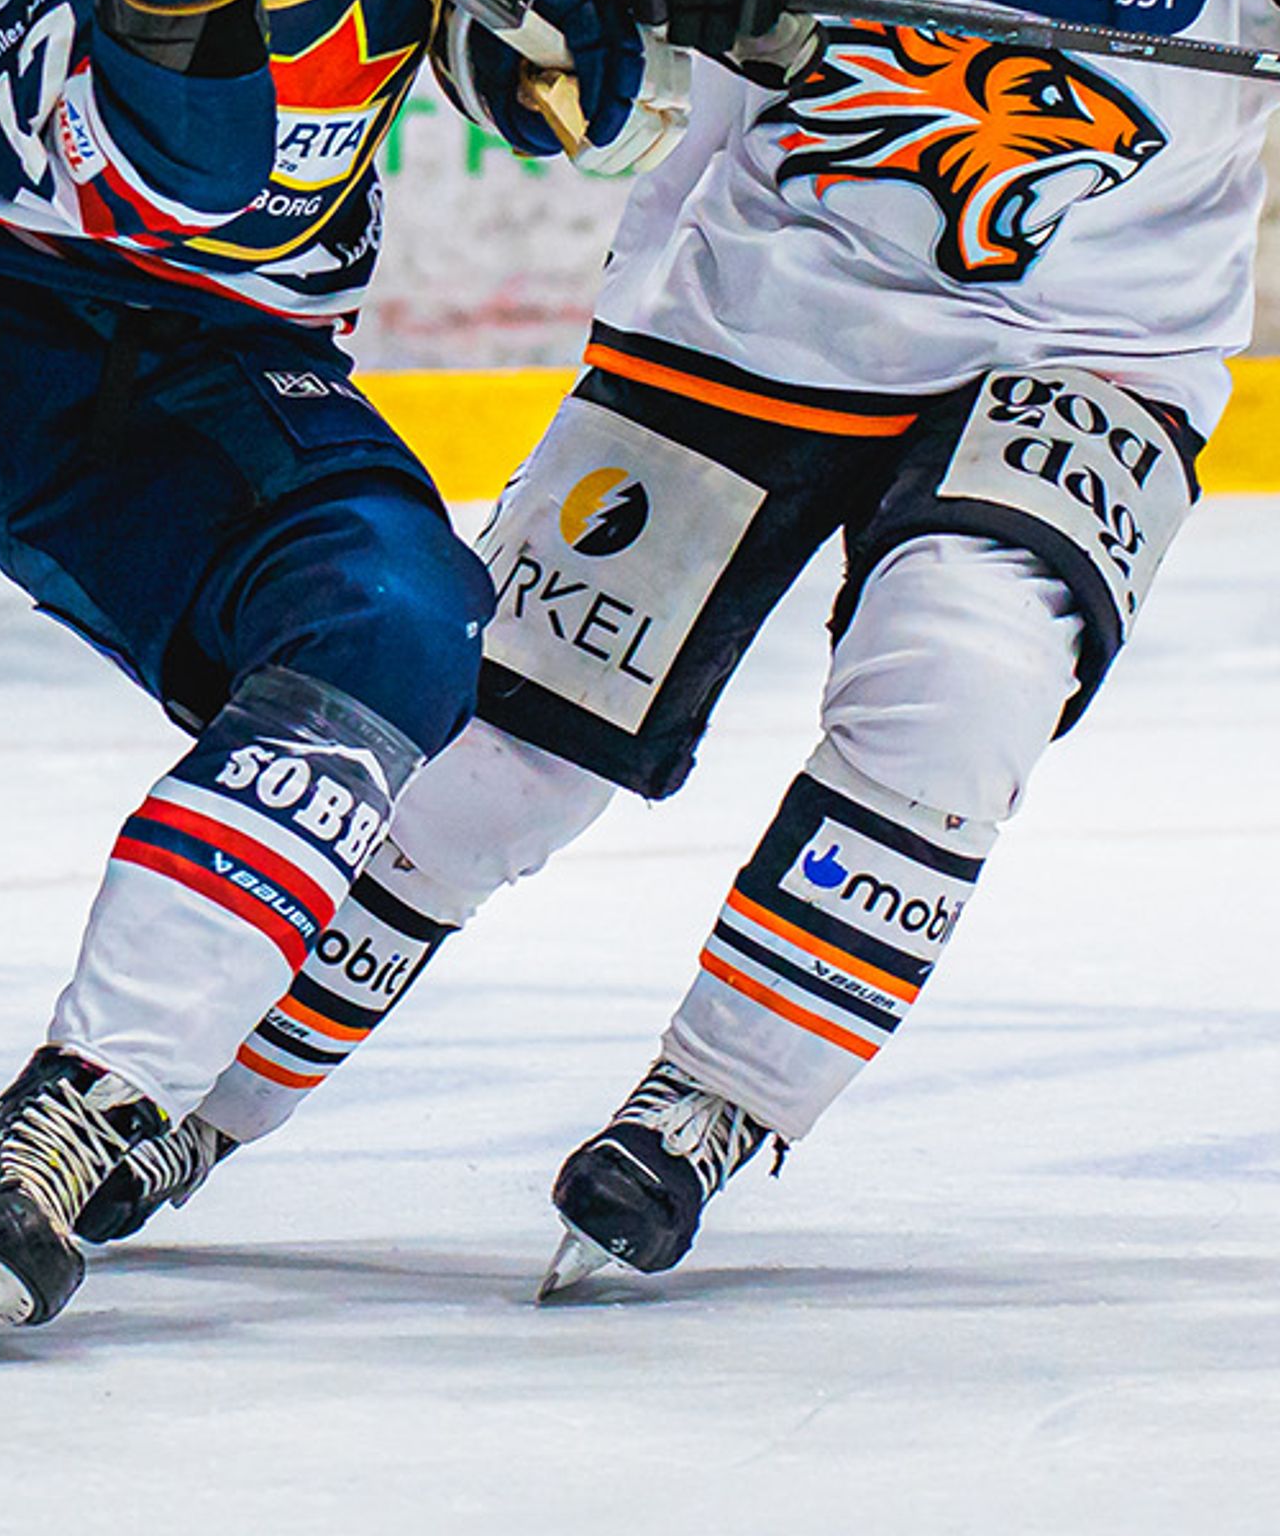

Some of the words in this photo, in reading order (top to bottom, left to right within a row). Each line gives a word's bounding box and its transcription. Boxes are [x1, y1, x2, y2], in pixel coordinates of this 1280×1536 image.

[495, 553, 655, 687] RKEL
[214, 744, 390, 877] SOBB
[840, 872, 965, 944] mob
[316, 928, 410, 996] obit
